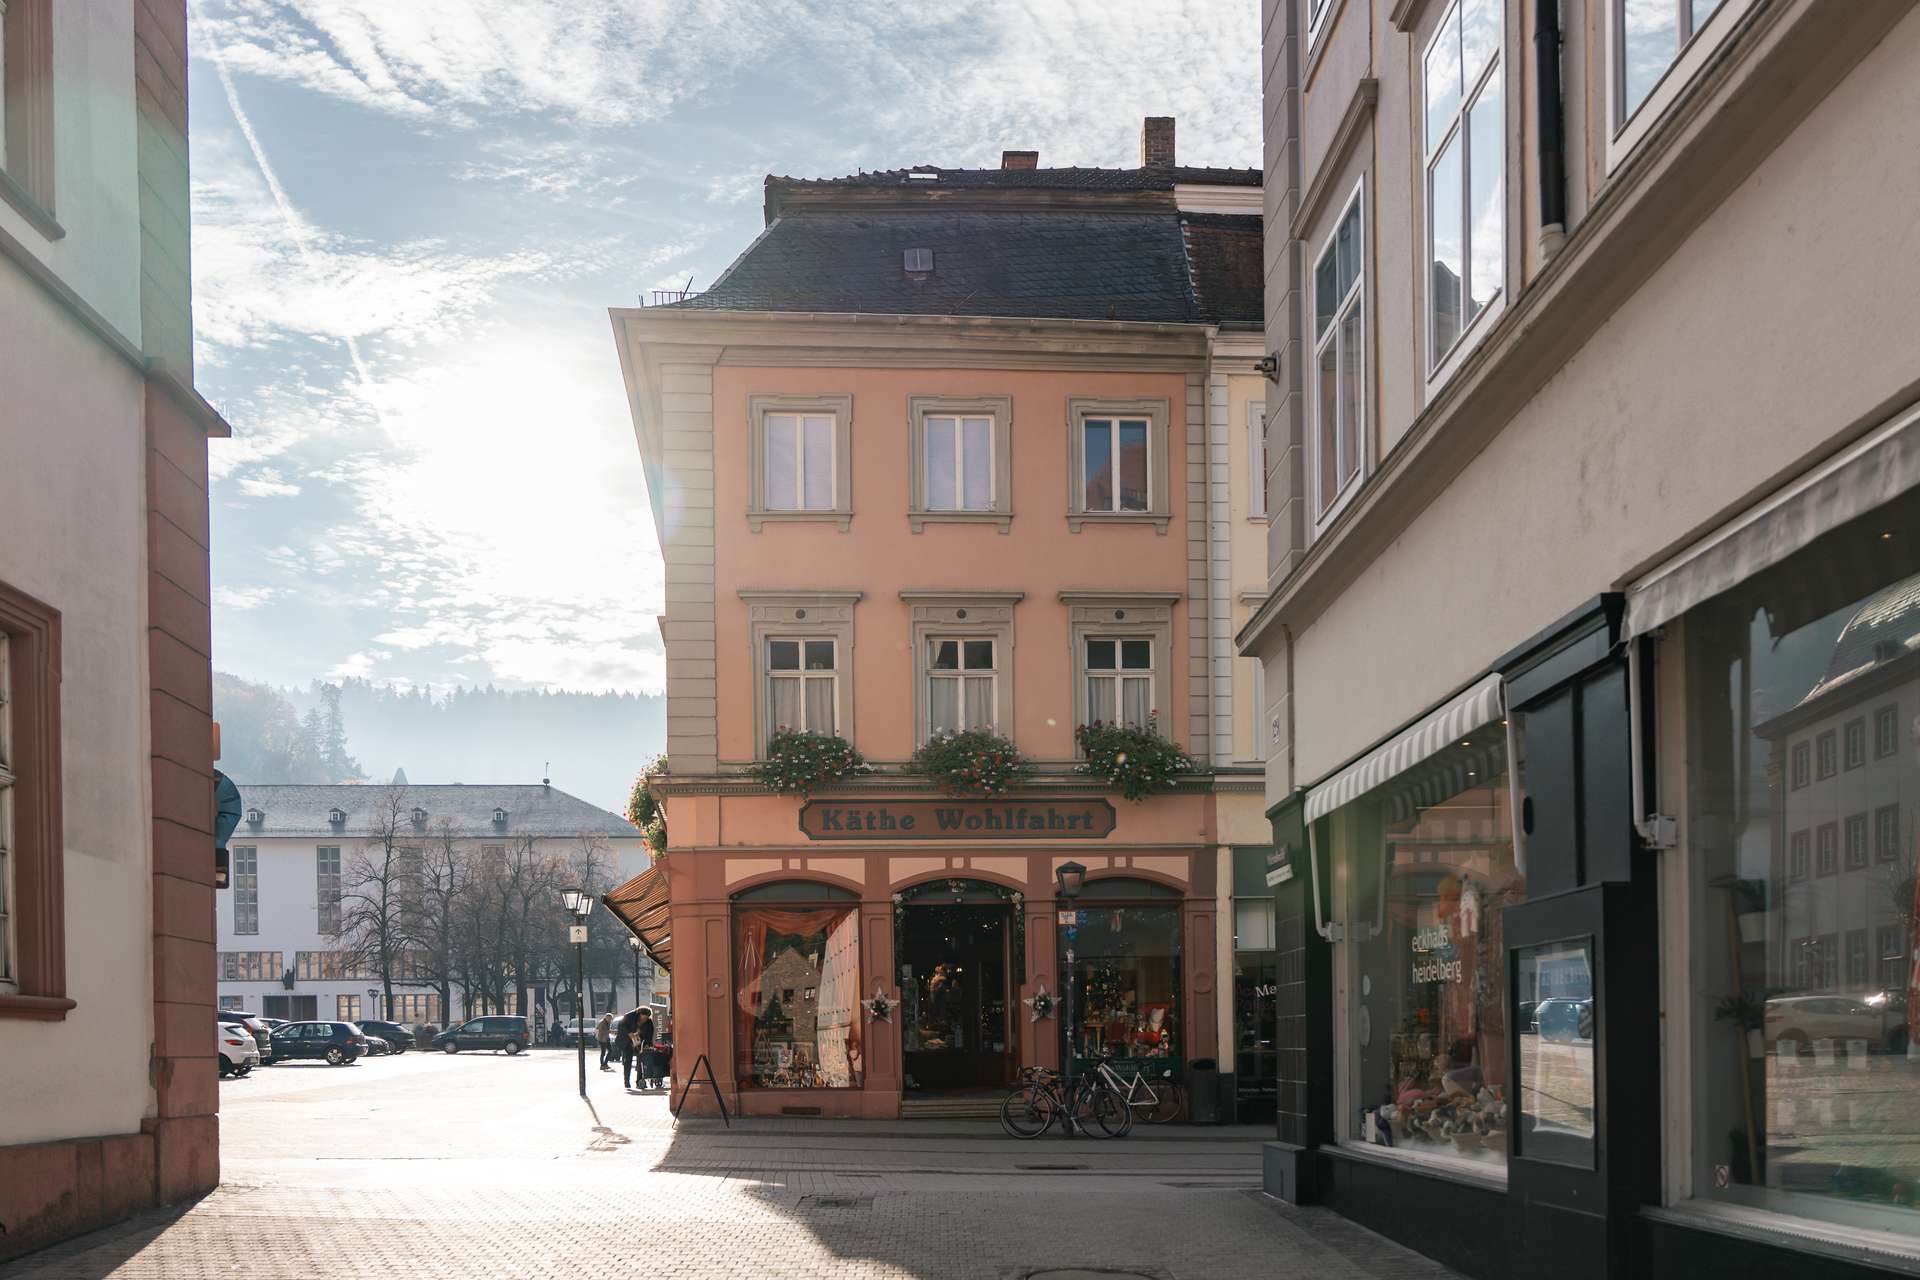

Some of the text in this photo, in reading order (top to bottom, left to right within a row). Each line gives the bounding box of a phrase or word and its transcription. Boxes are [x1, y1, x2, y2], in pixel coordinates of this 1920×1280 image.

[820, 808, 1094, 831] Käthe Wohlfahrt
[1412, 957, 1462, 985] heidelberg
